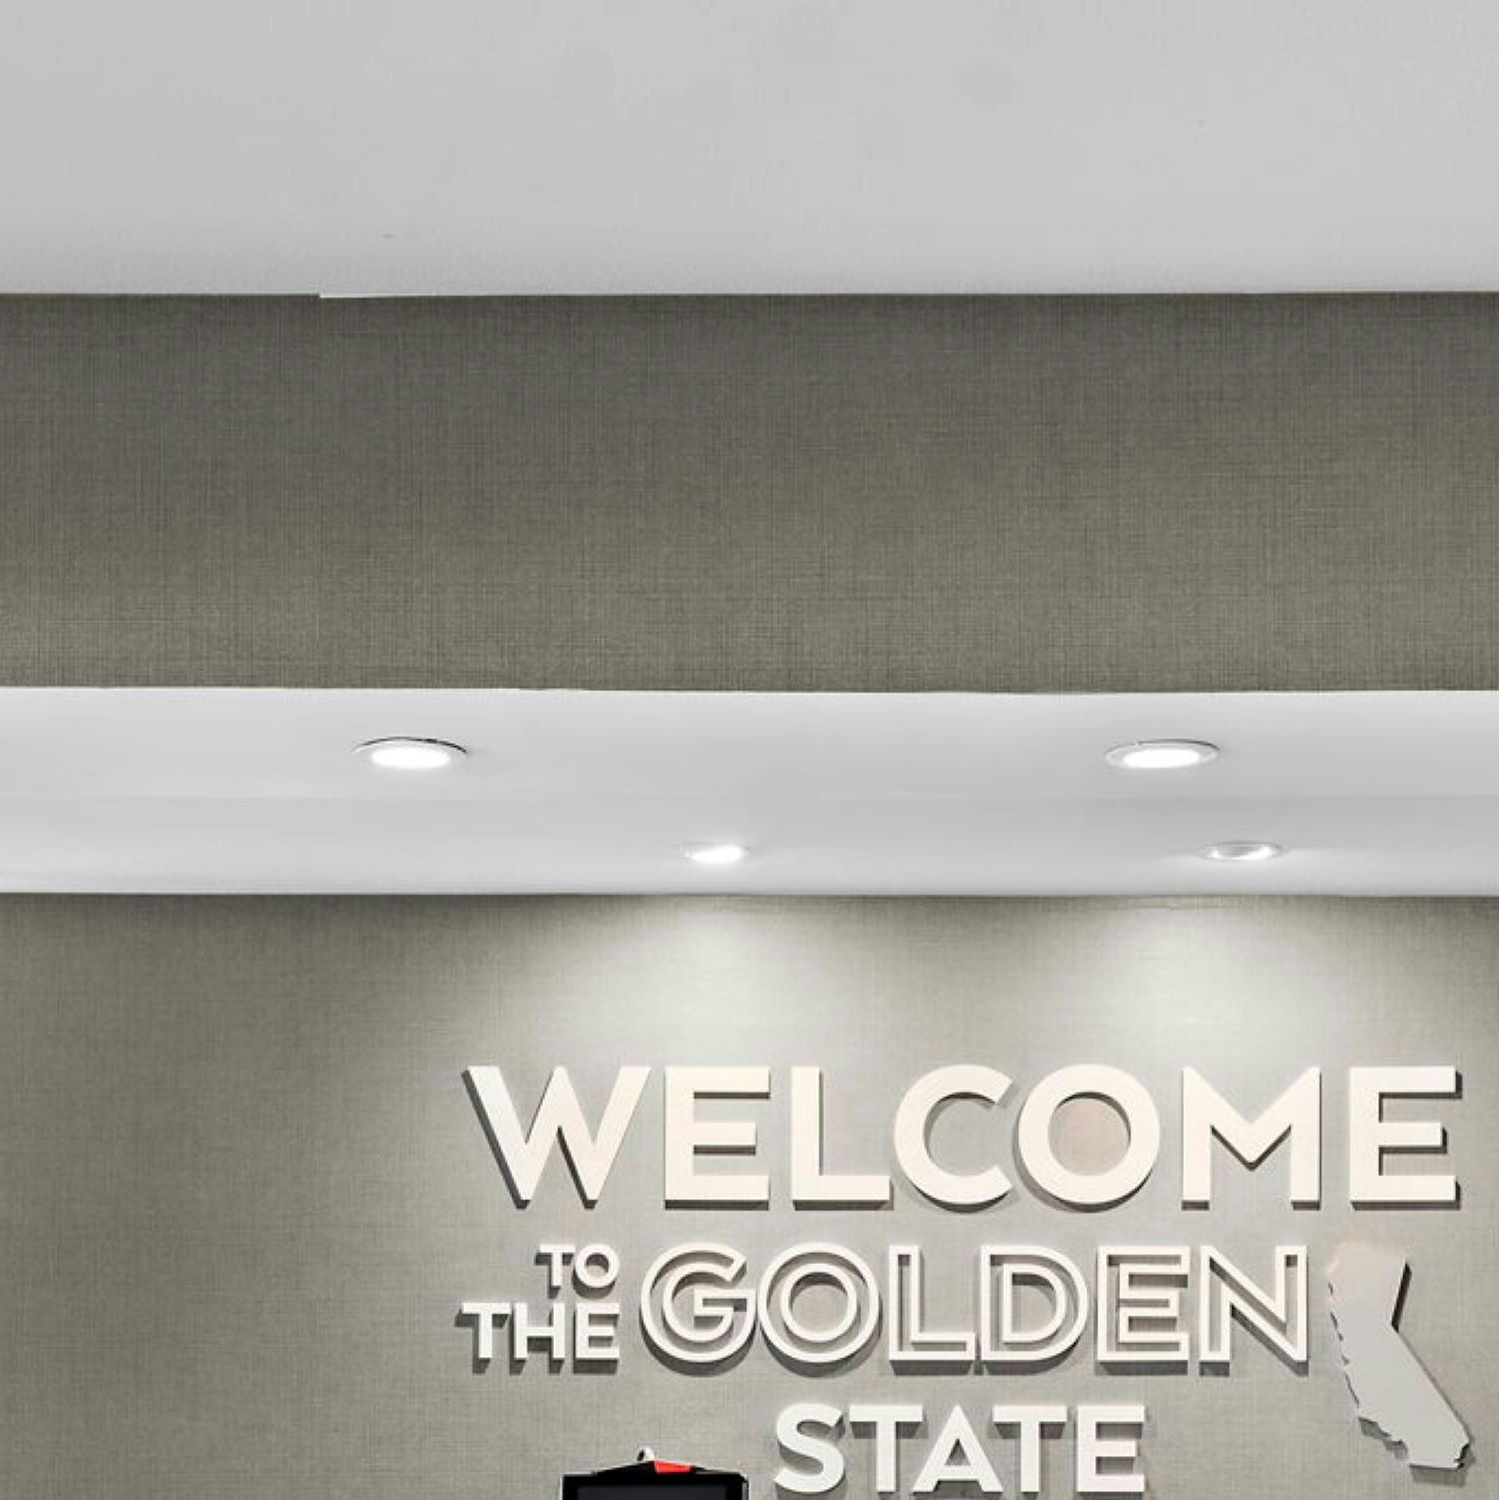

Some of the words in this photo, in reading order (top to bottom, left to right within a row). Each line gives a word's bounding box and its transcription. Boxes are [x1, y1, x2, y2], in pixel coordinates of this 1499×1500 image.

[467, 1064, 1457, 1205] WELCOME
[463, 1301, 620, 1360] THE
[639, 1244, 1308, 1364] GOLDEN
[539, 1244, 620, 1288] TO
[773, 1404, 1147, 1494] STATE
